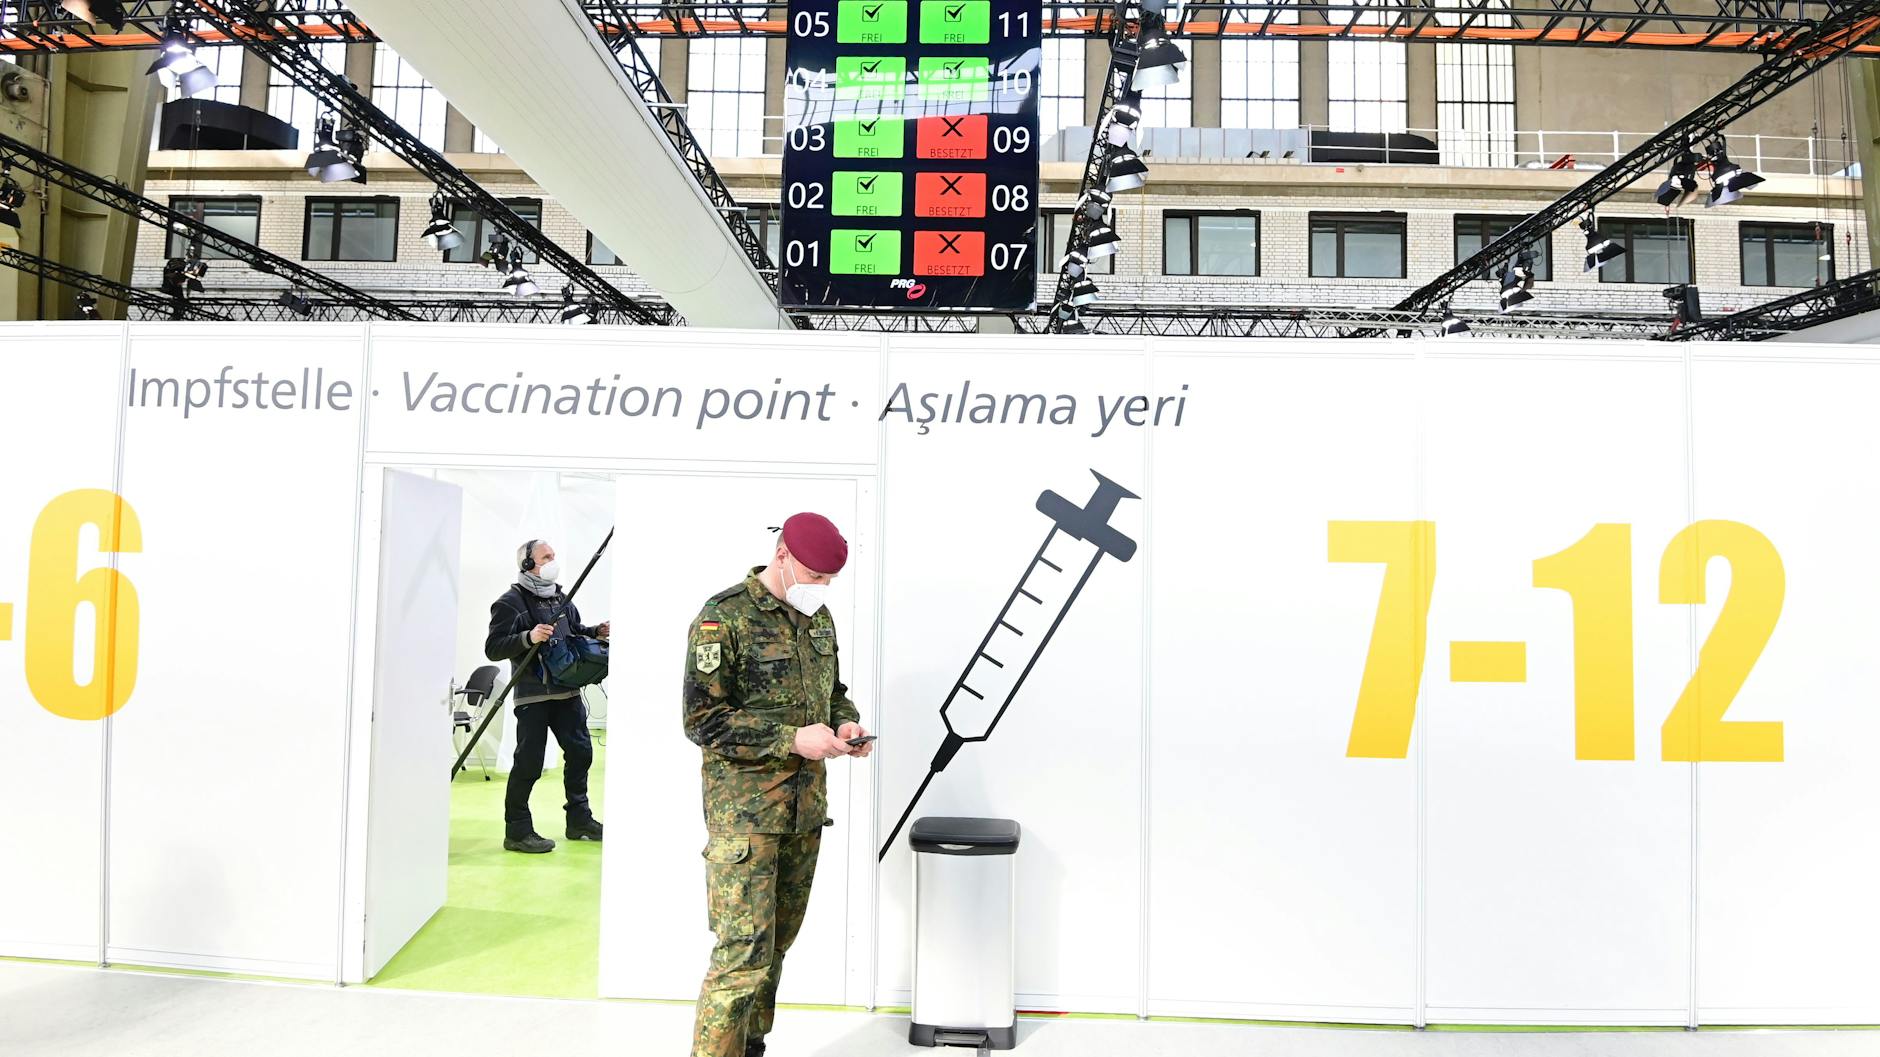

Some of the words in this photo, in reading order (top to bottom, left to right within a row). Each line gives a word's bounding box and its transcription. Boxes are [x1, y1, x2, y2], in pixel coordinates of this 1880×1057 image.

[794, 11, 830, 38] 05
[861, 33, 882, 42] FREI
[944, 33, 965, 43] FREI
[998, 12, 1029, 38] 11
[793, 67, 829, 93] 04
[998, 68, 1032, 95] 10
[789, 125, 826, 152] 03
[858, 147, 879, 157] FREI
[930, 148, 974, 158] BESETZT
[993, 126, 1030, 154] 09
[788, 182, 824, 209] 02
[856, 205, 878, 215] FREI
[928, 206, 972, 217] BESETZT
[992, 184, 1029, 212] 08
[786, 240, 819, 267] 01
[854, 264, 876, 274] FREI
[927, 265, 971, 276] BESETZT
[990, 243, 1028, 271] 07
[890, 279, 916, 289] PRG
[128, 365, 353, 419] Impfstelle
[403, 371, 683, 418] Vaccination
[696, 377, 836, 430] point
[878, 380, 1077, 436] Aşılama
[1091, 383, 1189, 438] yeri
[1328, 519, 1787, 763] 7-12
